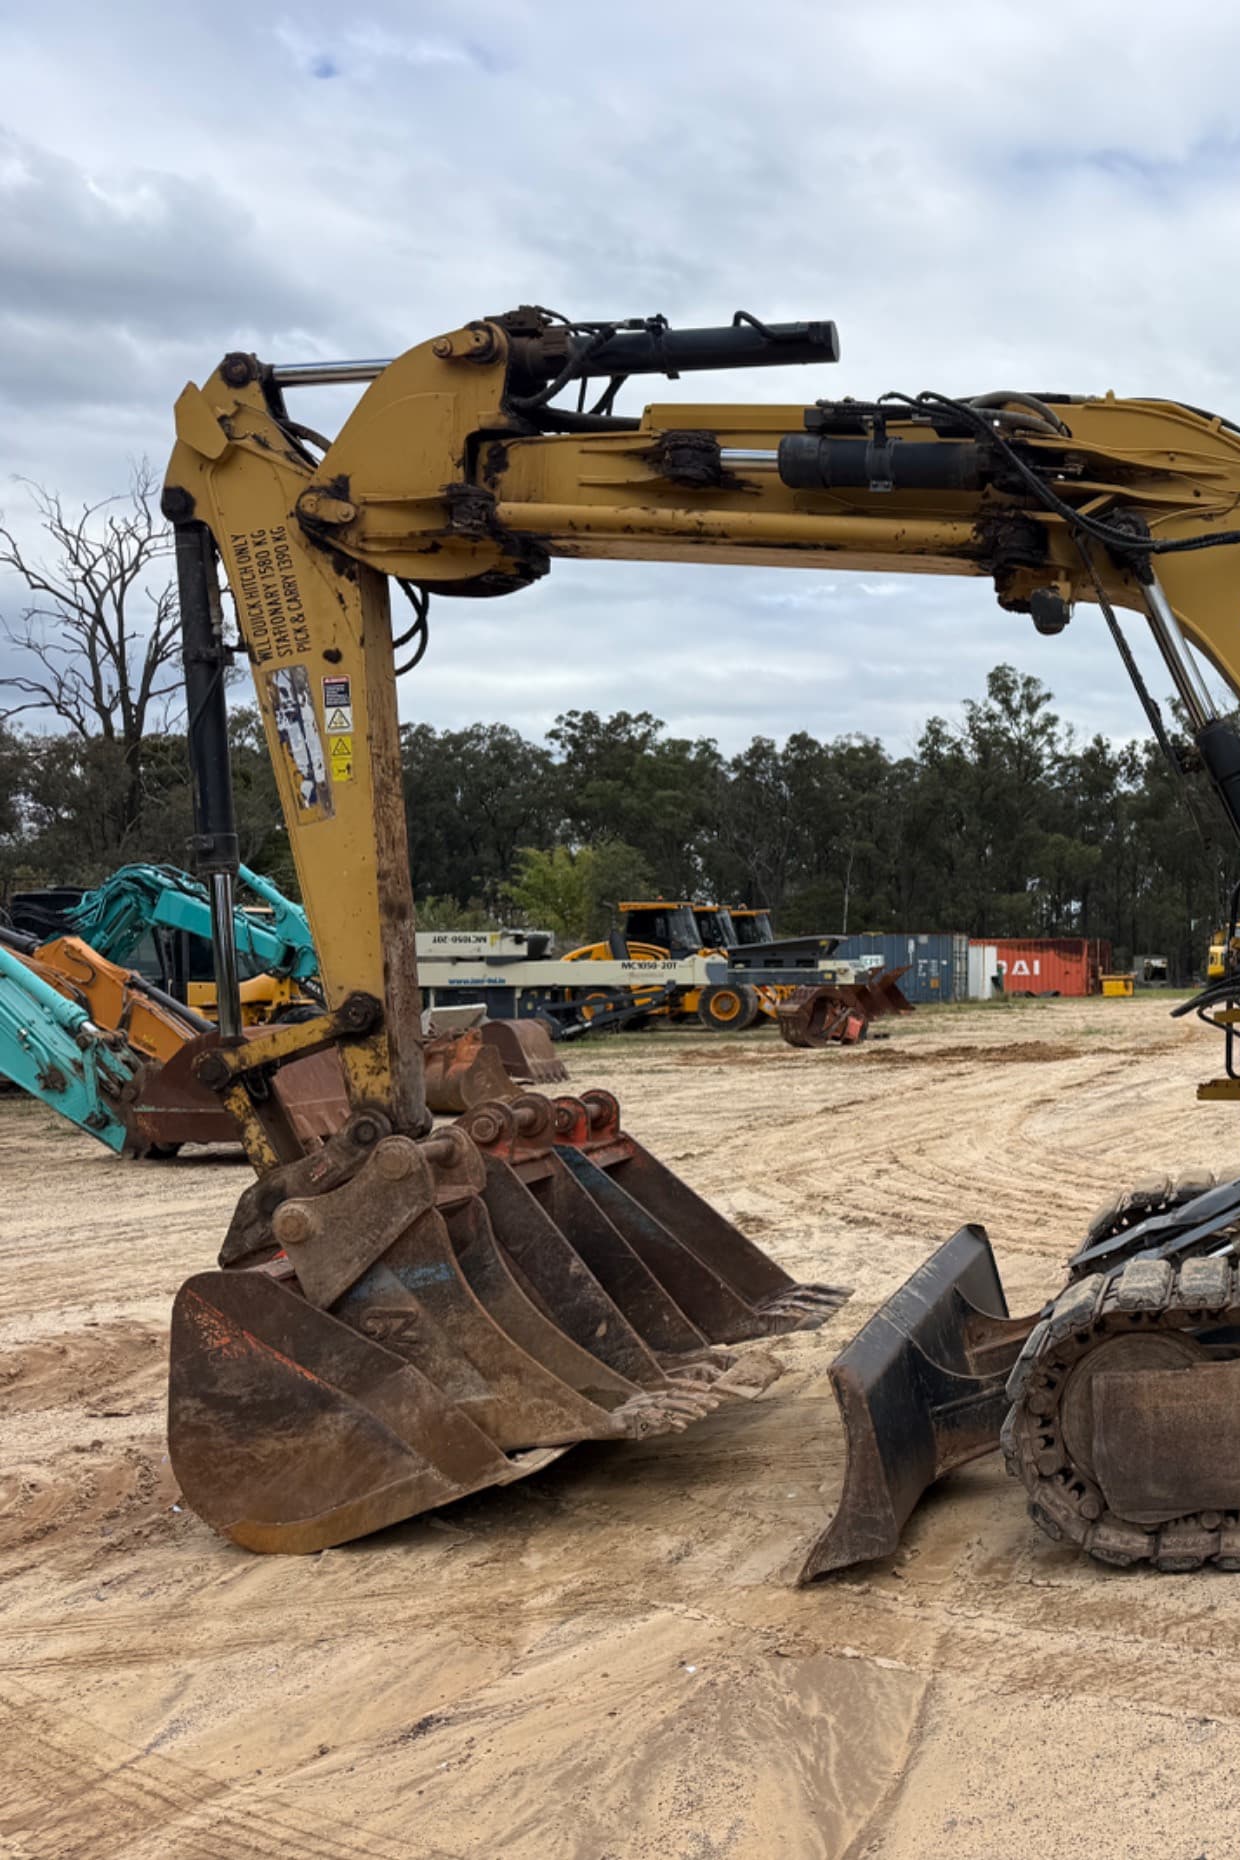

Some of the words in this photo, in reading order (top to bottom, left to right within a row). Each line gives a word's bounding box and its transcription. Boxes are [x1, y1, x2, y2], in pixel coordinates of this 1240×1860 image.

[250, 529, 267, 547] KG
[269, 526, 288, 542] KG
[230, 534, 251, 564] ONLY
[274, 544, 293, 571] 1390
[255, 550, 275, 580] 1580
[238, 565, 260, 600] HITCH
[280, 574, 304, 612] CARRY
[246, 600, 269, 638] QUICK
[262, 583, 294, 658] STATIONARY
[289, 613, 306, 624] &
[257, 637, 273, 661] WLL
[293, 625, 312, 653] PICK
